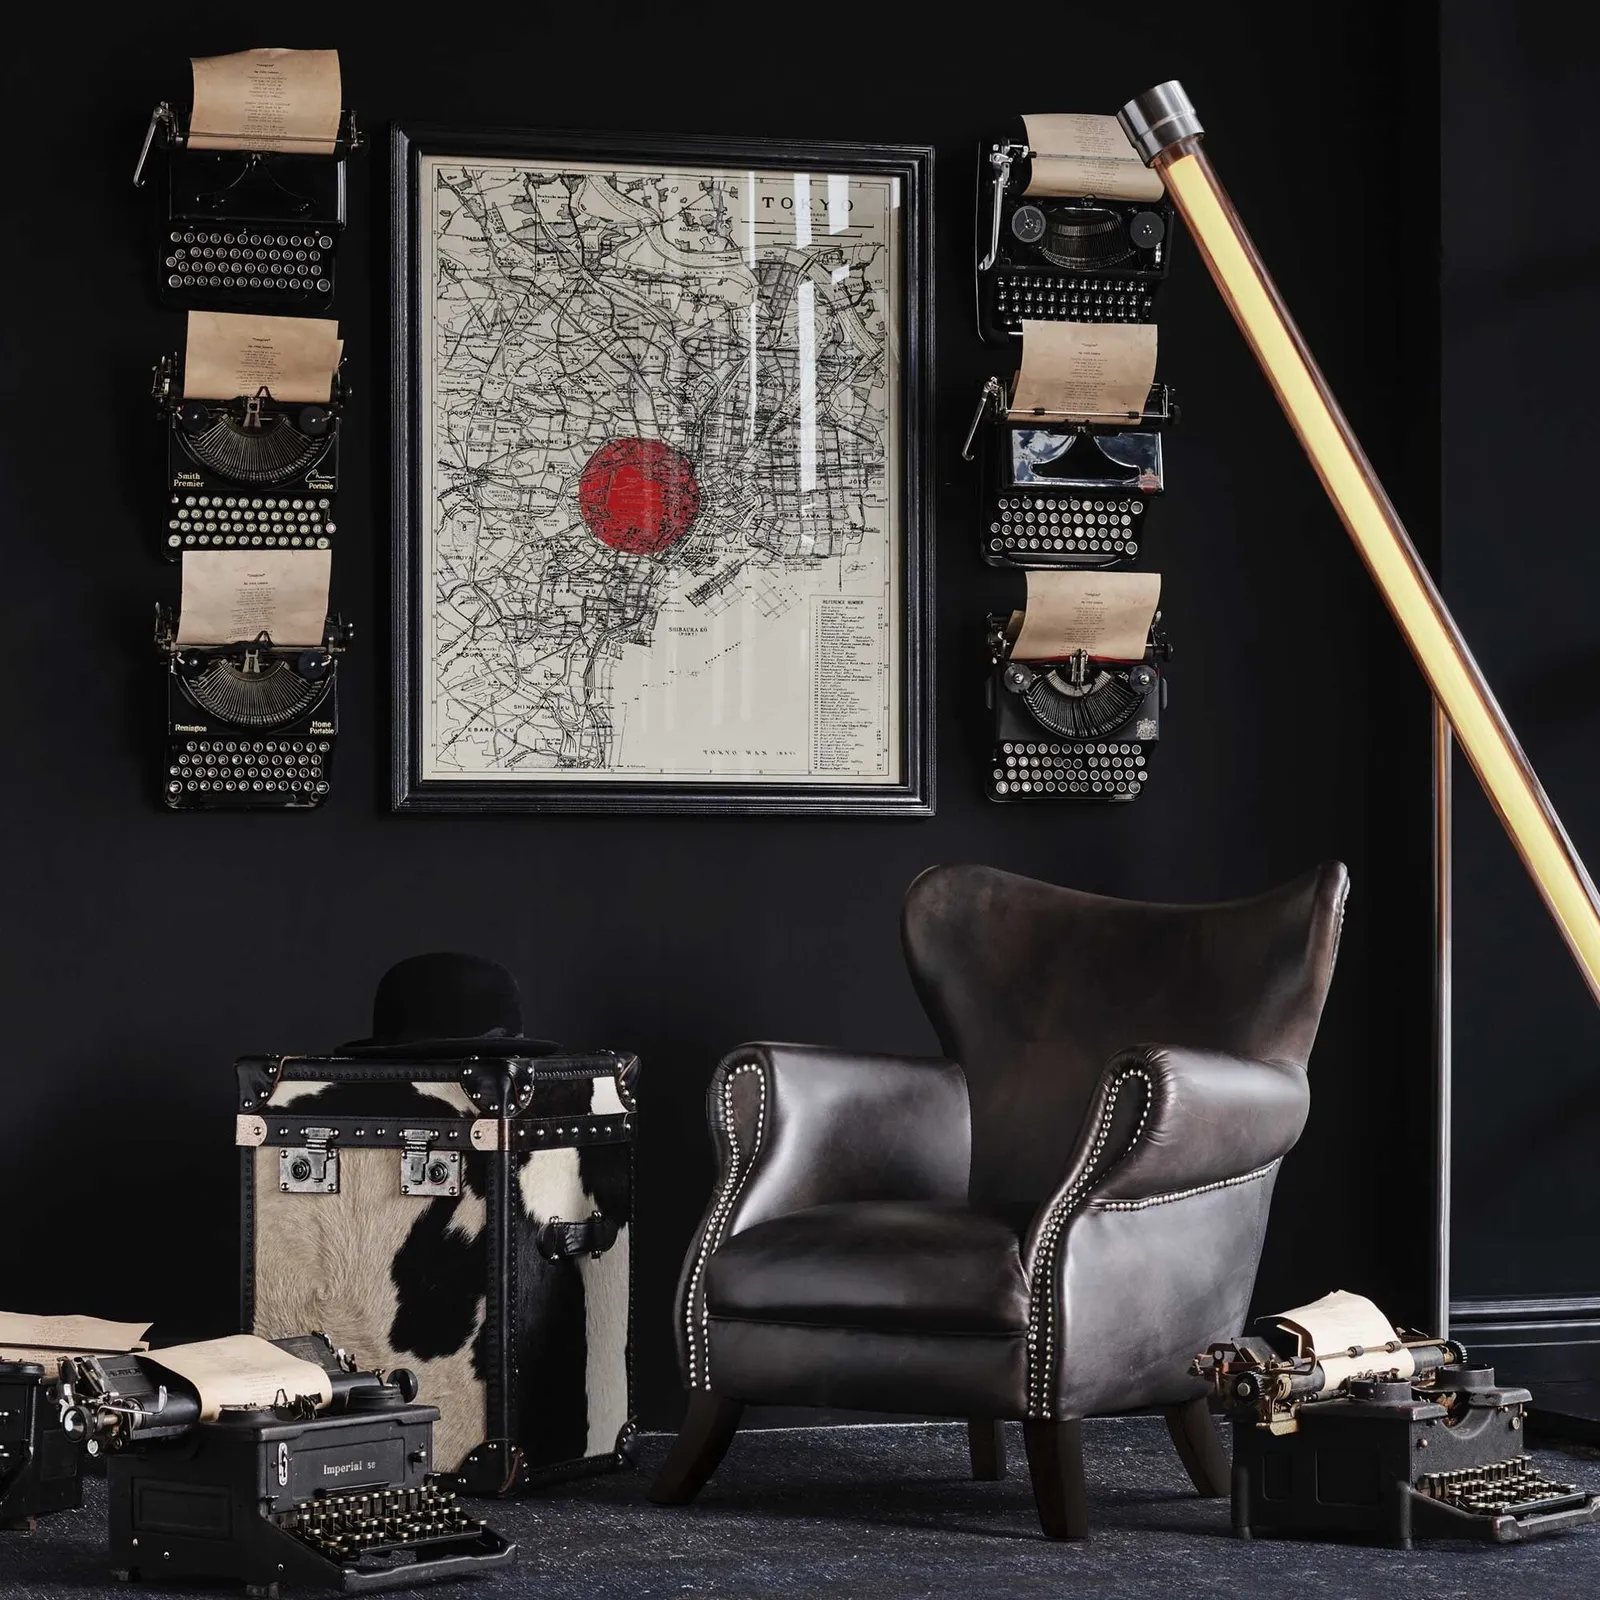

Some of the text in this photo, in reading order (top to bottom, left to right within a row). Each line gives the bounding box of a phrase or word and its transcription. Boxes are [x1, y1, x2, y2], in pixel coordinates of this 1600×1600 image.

[761, 196, 854, 212] TOKYO
[177, 472, 200, 480] Smith
[173, 480, 204, 488] Premier
[308, 482, 334, 490] Portable
[309, 727, 335, 735] Portable
[323, 1460, 363, 1476] Imperial
